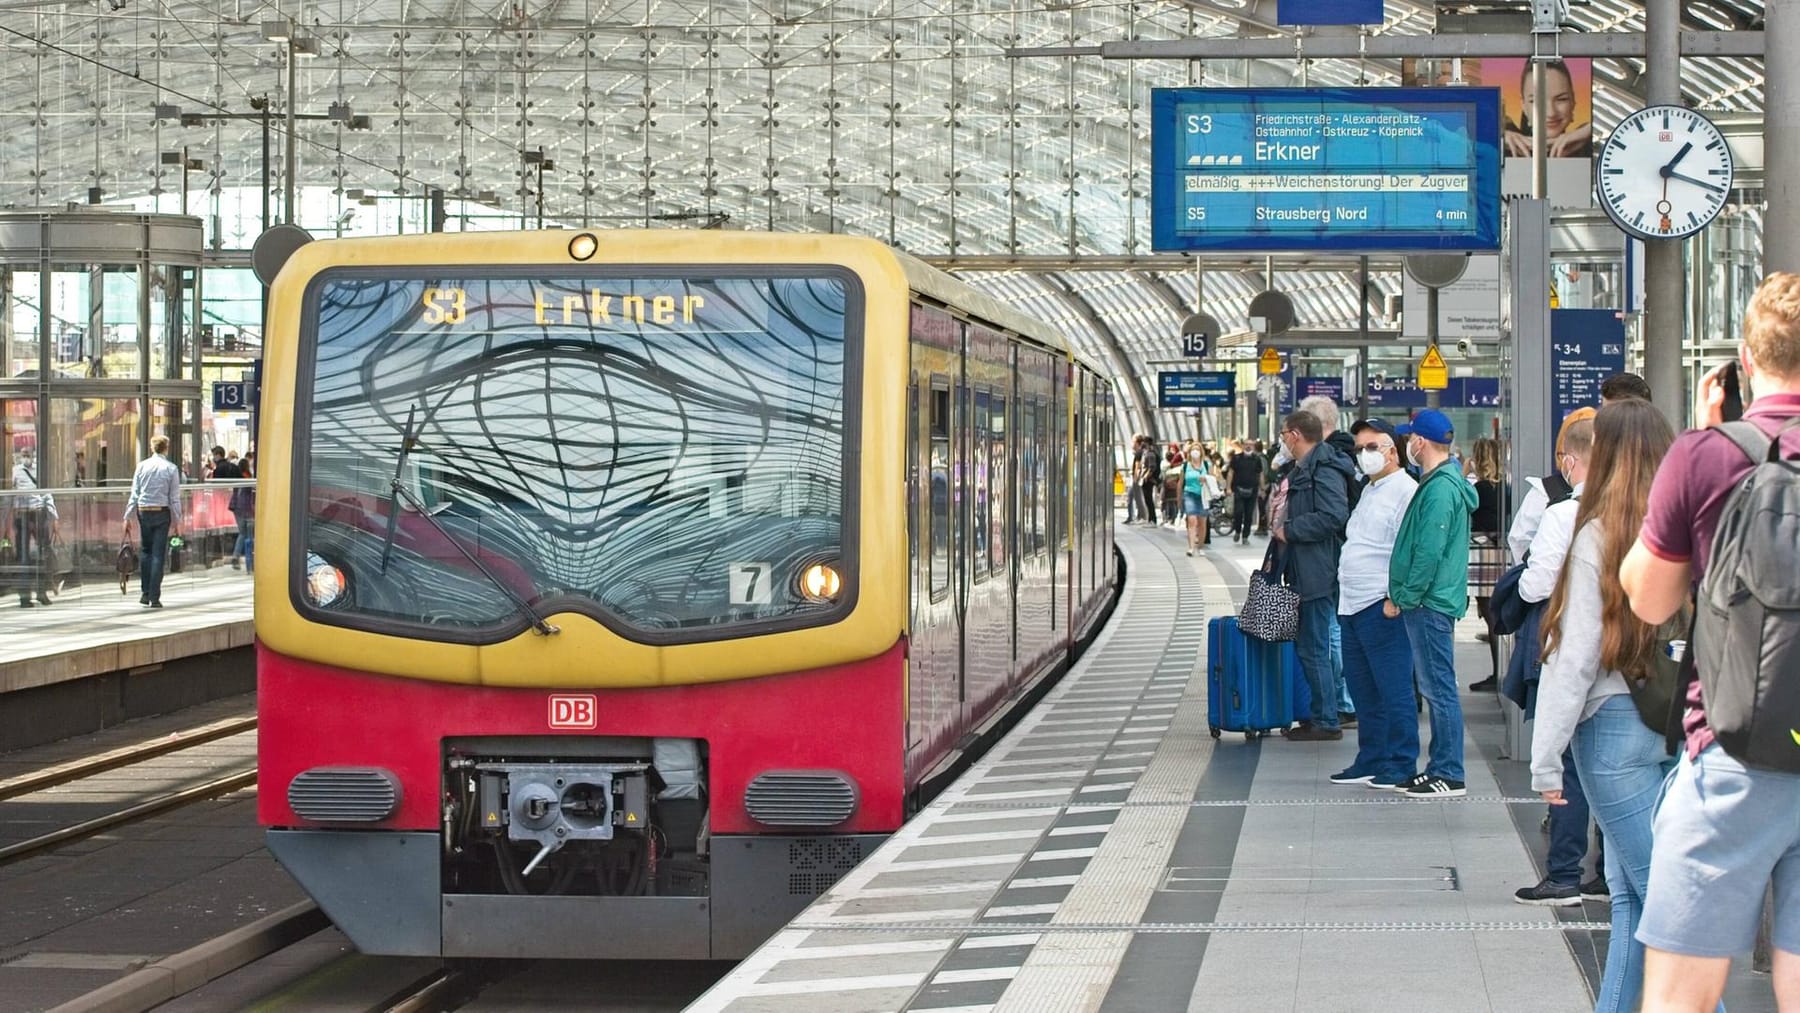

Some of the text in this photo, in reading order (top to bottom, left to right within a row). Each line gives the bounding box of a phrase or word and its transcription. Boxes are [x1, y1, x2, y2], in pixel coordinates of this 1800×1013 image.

[1188, 115, 1212, 134] S3
[1255, 114, 1332, 125] Friedrichstraße
[1341, 114, 1420, 126] Alexanderplatz
[1255, 127, 1312, 137] Ostbahnhof
[1322, 127, 1369, 137] Ostkreuz
[1378, 126, 1424, 138] Köpenick
[1255, 141, 1320, 161] Erkner
[1390, 175, 1413, 188] Der
[1420, 175, 1467, 190] Zugver
[1187, 206, 1468, 224] S5 Strausberg Nord 4 min
[422, 287, 704, 325] S3 Erkner
[1184, 334, 1204, 351] 15
[1563, 343, 1581, 355] 3-4
[217, 385, 238, 404] 13
[740, 566, 763, 602] 7
[555, 700, 590, 722] DB
